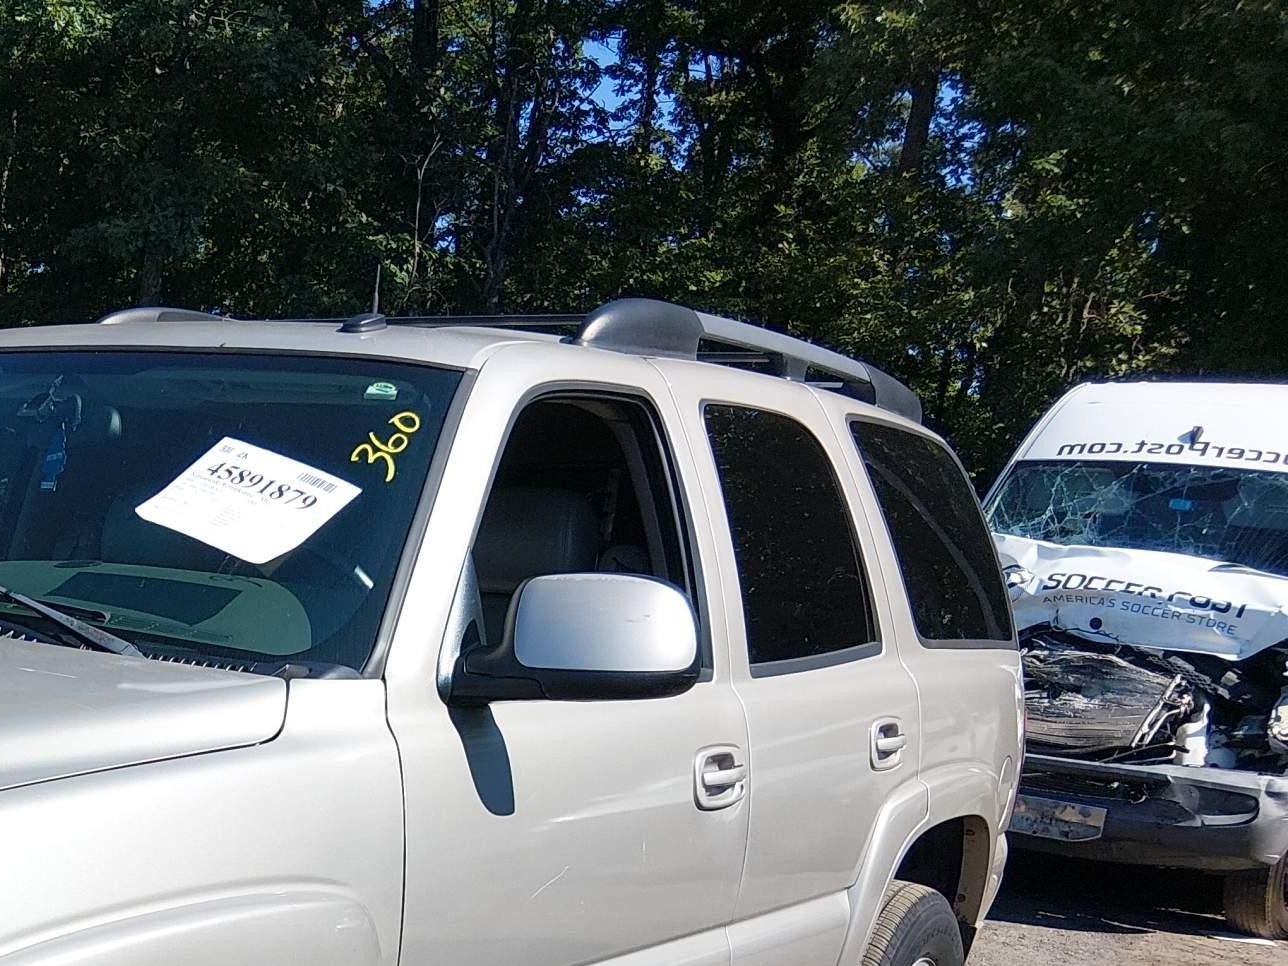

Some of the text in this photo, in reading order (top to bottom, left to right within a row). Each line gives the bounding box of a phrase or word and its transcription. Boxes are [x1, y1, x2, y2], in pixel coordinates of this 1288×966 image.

[350, 411, 421, 483] 360
[206, 461, 318, 510] 45891879
[1042, 594, 1239, 636] AMERICAS SOCCER STORE
